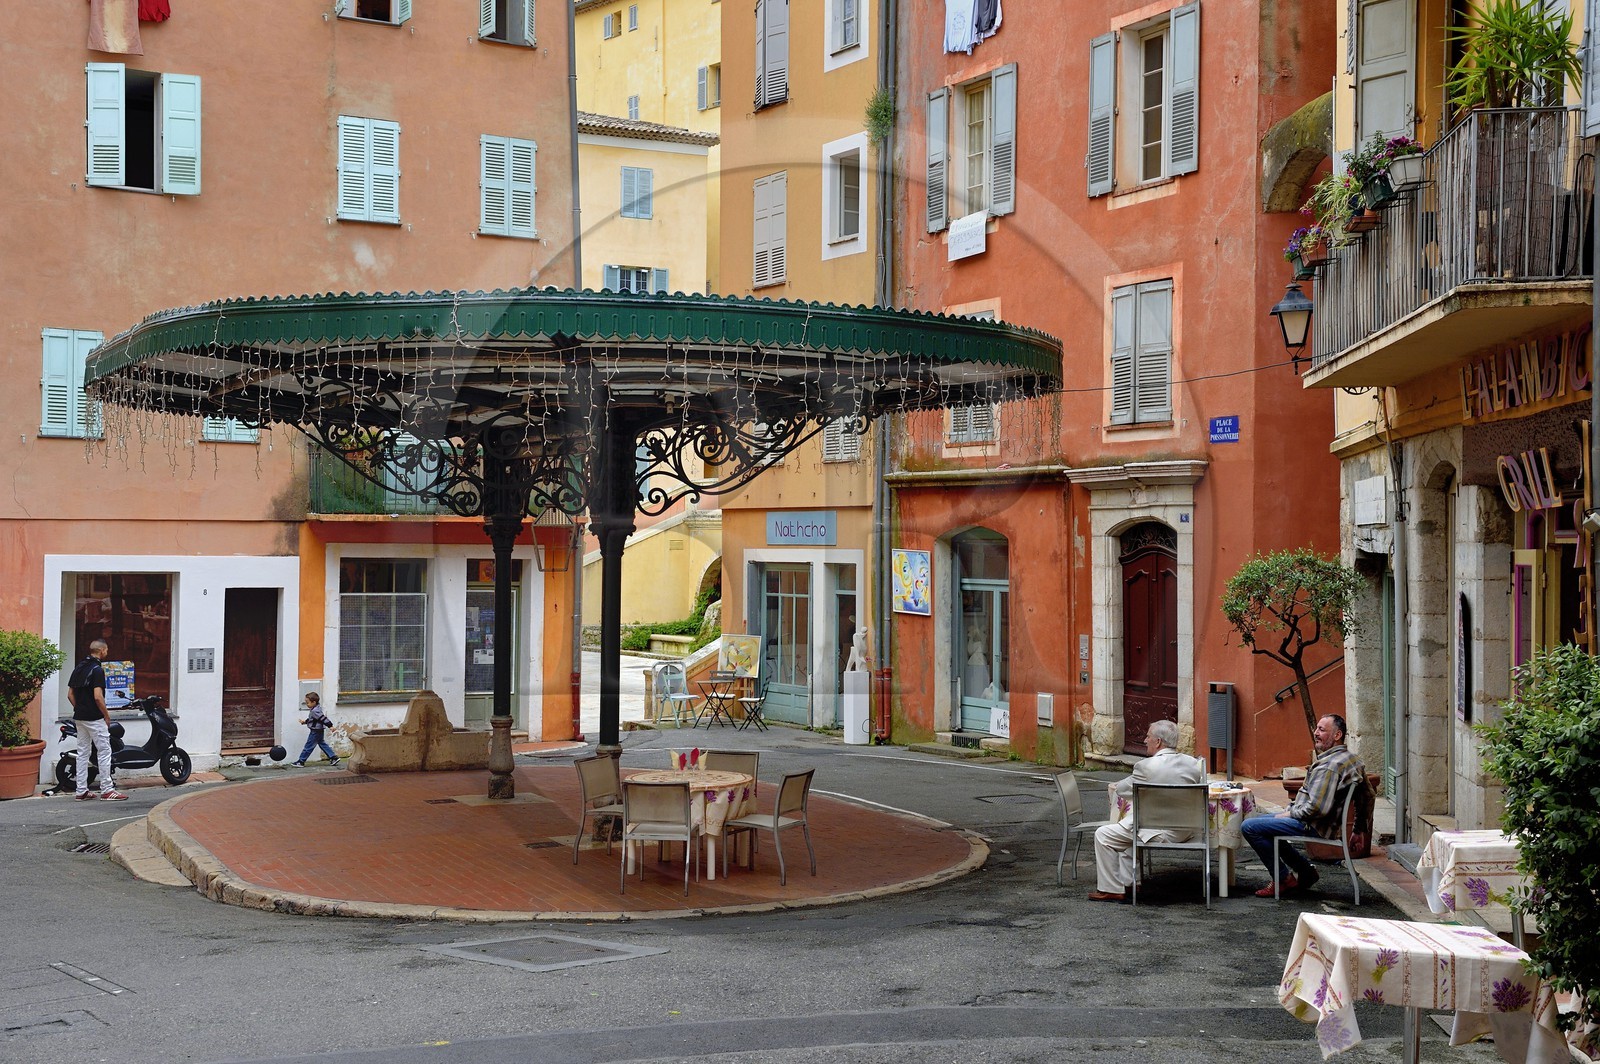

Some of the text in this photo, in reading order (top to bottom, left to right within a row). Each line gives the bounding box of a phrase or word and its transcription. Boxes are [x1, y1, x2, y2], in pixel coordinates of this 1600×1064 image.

[1459, 321, 1592, 420] L'ALAMBIC
[1216, 419, 1232, 427] PLACE
[1210, 432, 1239, 441] POISSONNERIE
[1496, 447, 1565, 512] GRILL
[775, 521, 826, 537] Nathcho
